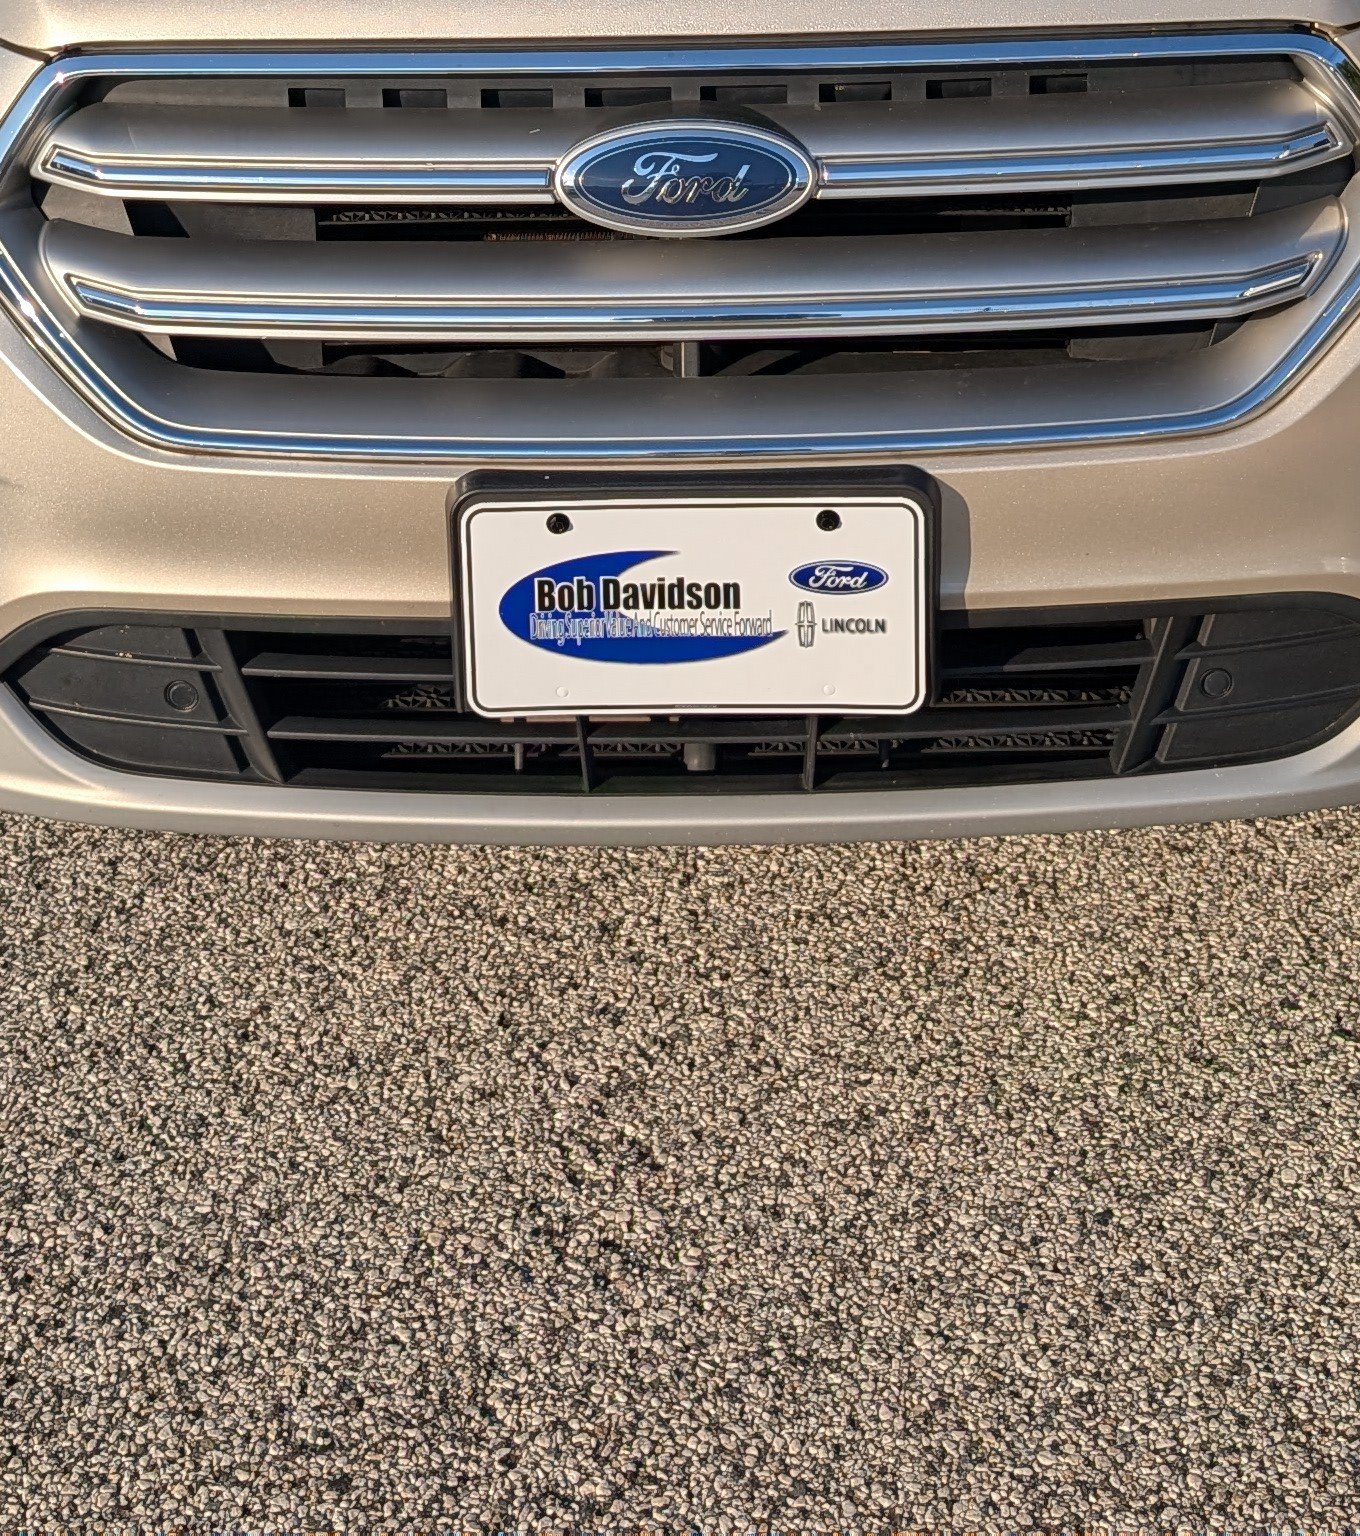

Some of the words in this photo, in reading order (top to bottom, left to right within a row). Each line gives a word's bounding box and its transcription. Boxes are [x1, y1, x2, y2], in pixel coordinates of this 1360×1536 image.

[621, 151, 752, 205] Ford
[536, 577, 596, 613] Bob
[601, 576, 742, 611] Davidson
[808, 564, 869, 592] Ford
[530, 613, 565, 647] Driving
[565, 611, 607, 646] Superior
[606, 611, 634, 639] Value
[633, 611, 653, 638] And
[654, 610, 700, 638] Customer
[700, 610, 733, 638] Service
[734, 609, 773, 637] Forward
[821, 616, 887, 635] LINCOLN
